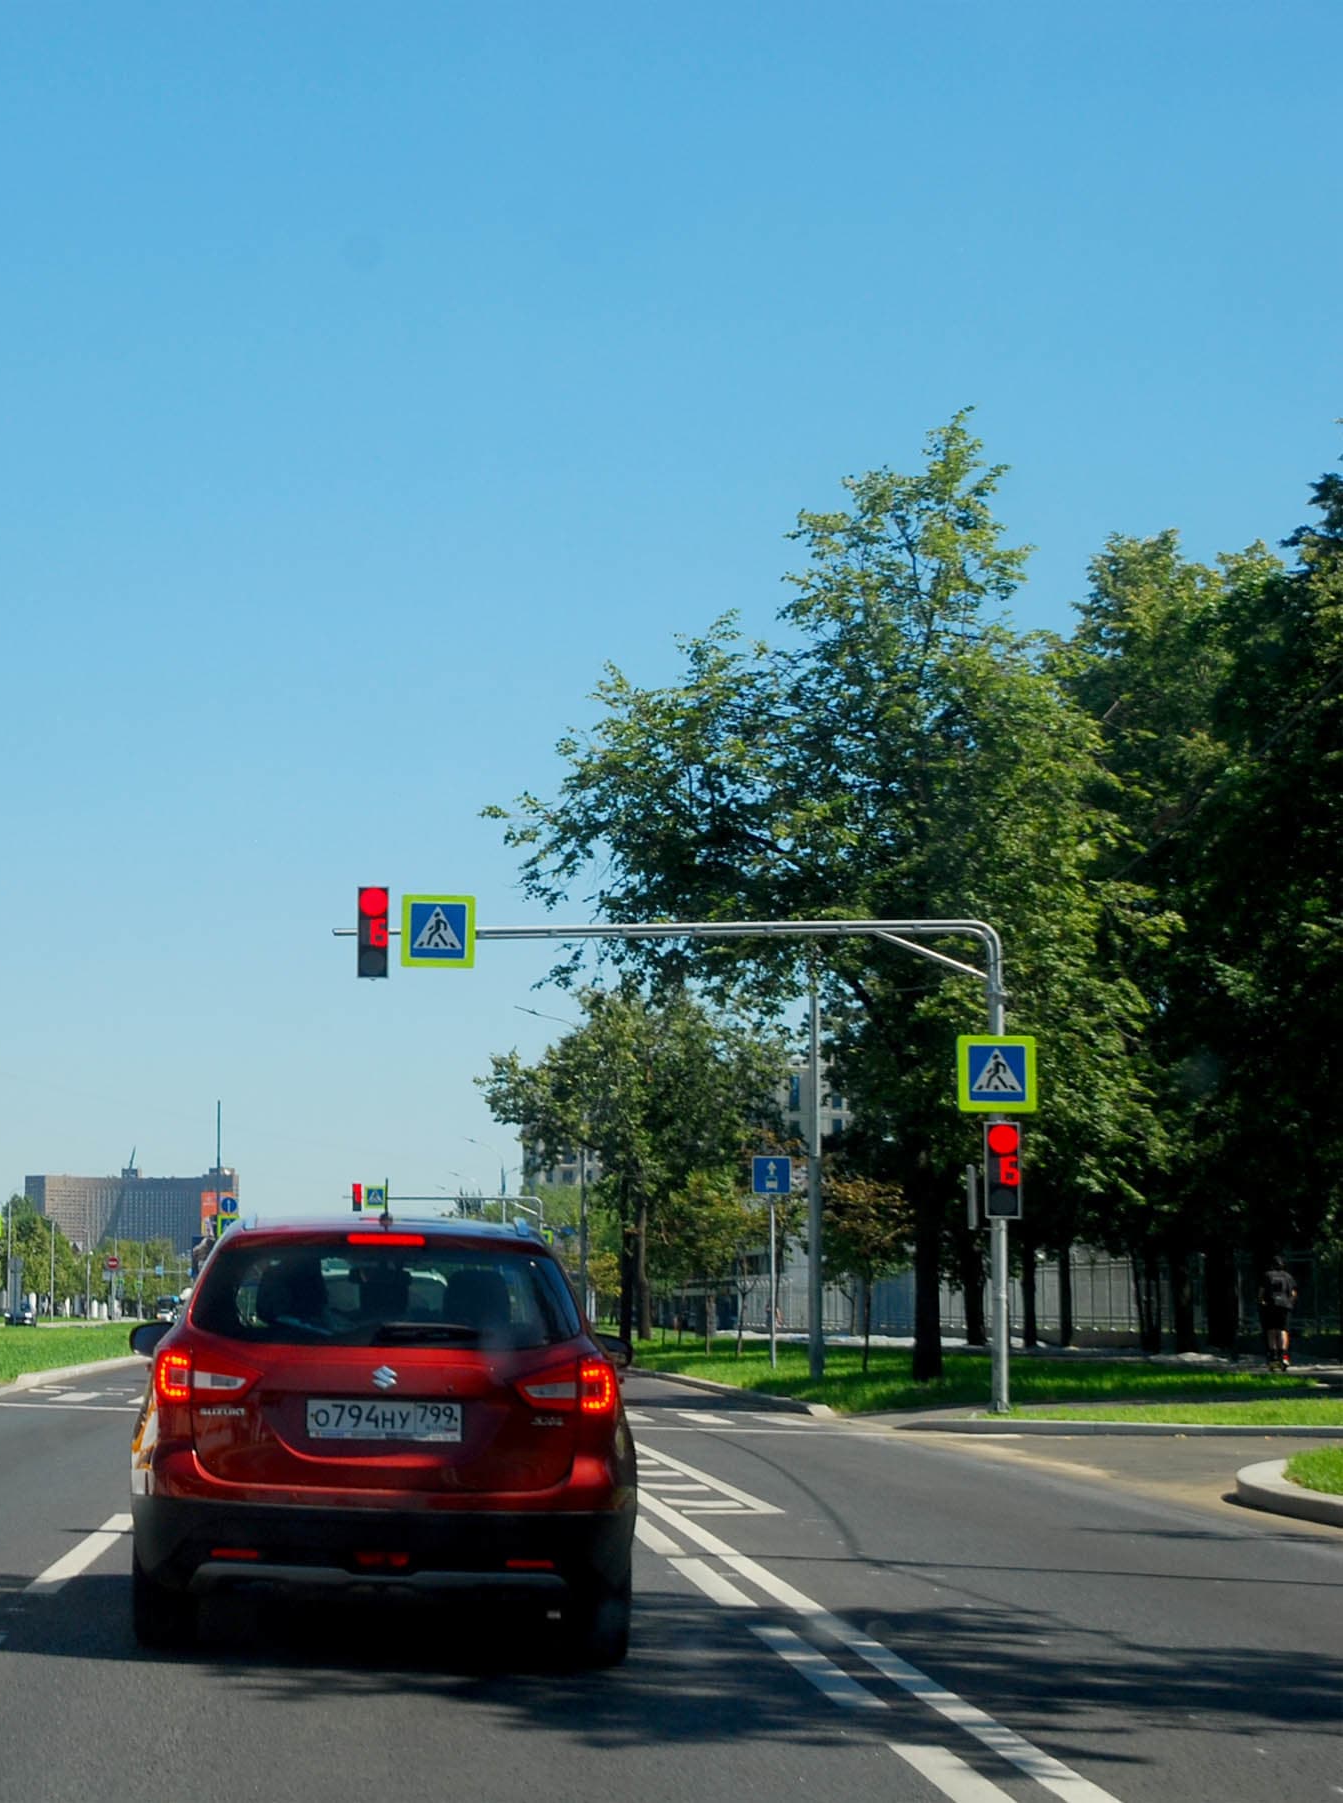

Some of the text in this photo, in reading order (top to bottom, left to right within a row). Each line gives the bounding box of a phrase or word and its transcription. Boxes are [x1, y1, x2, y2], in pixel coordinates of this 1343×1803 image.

[369, 917, 389, 948] 6
[999, 1154, 1021, 1187] 6
[416, 1404, 455, 1424] 799
